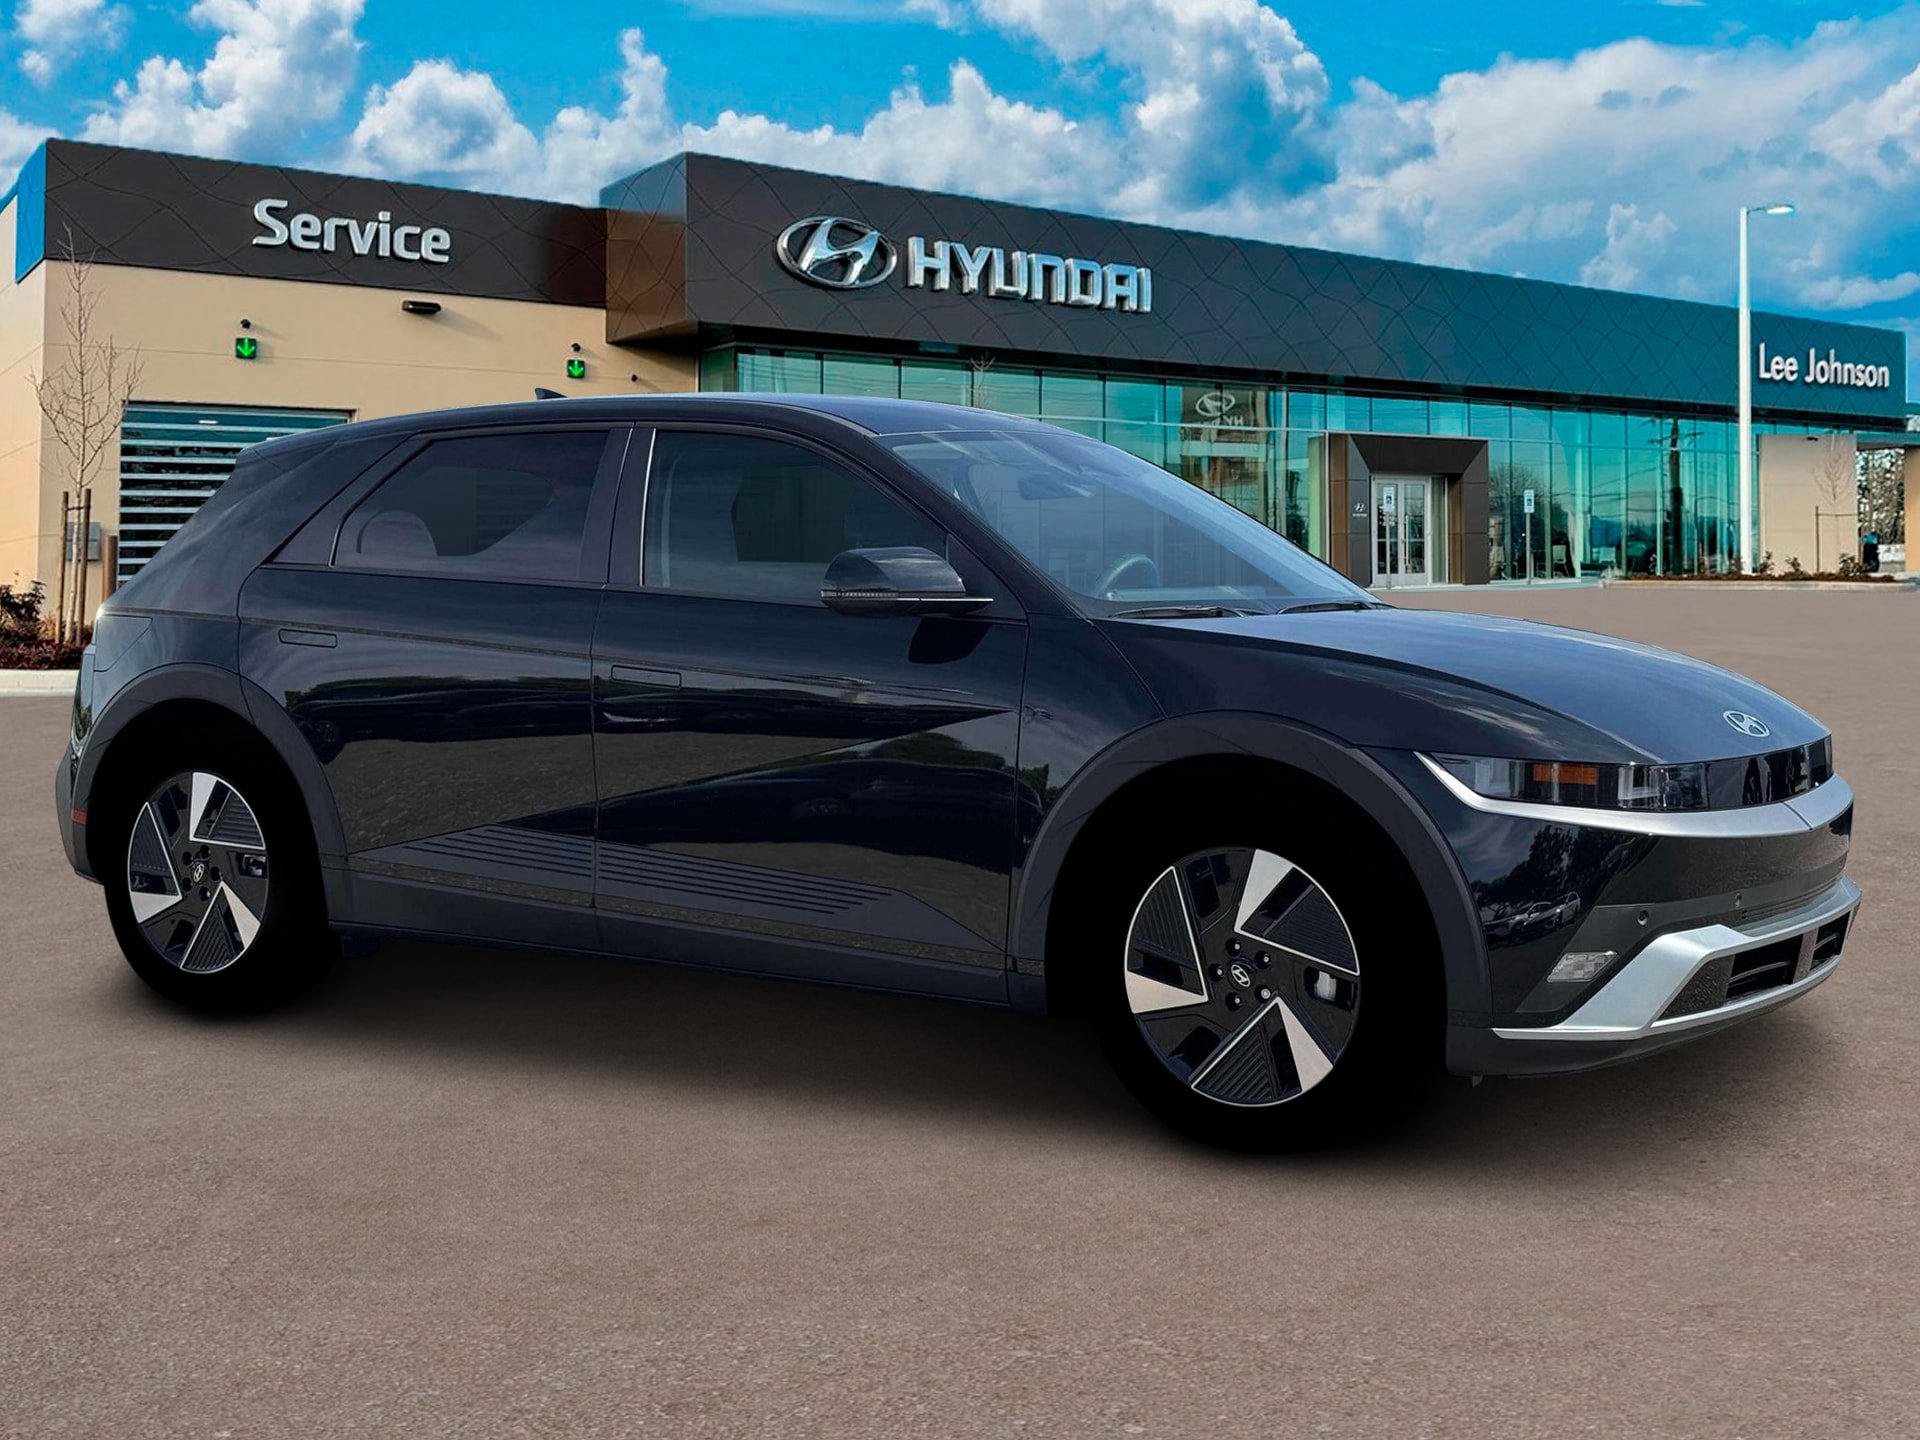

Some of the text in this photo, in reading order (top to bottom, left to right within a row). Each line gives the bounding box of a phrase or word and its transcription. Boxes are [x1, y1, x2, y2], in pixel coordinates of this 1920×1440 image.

[252, 198, 450, 263] Service
[907, 236, 1152, 313] HYUNDAI
[1759, 342, 1889, 388] Lee Johnson
